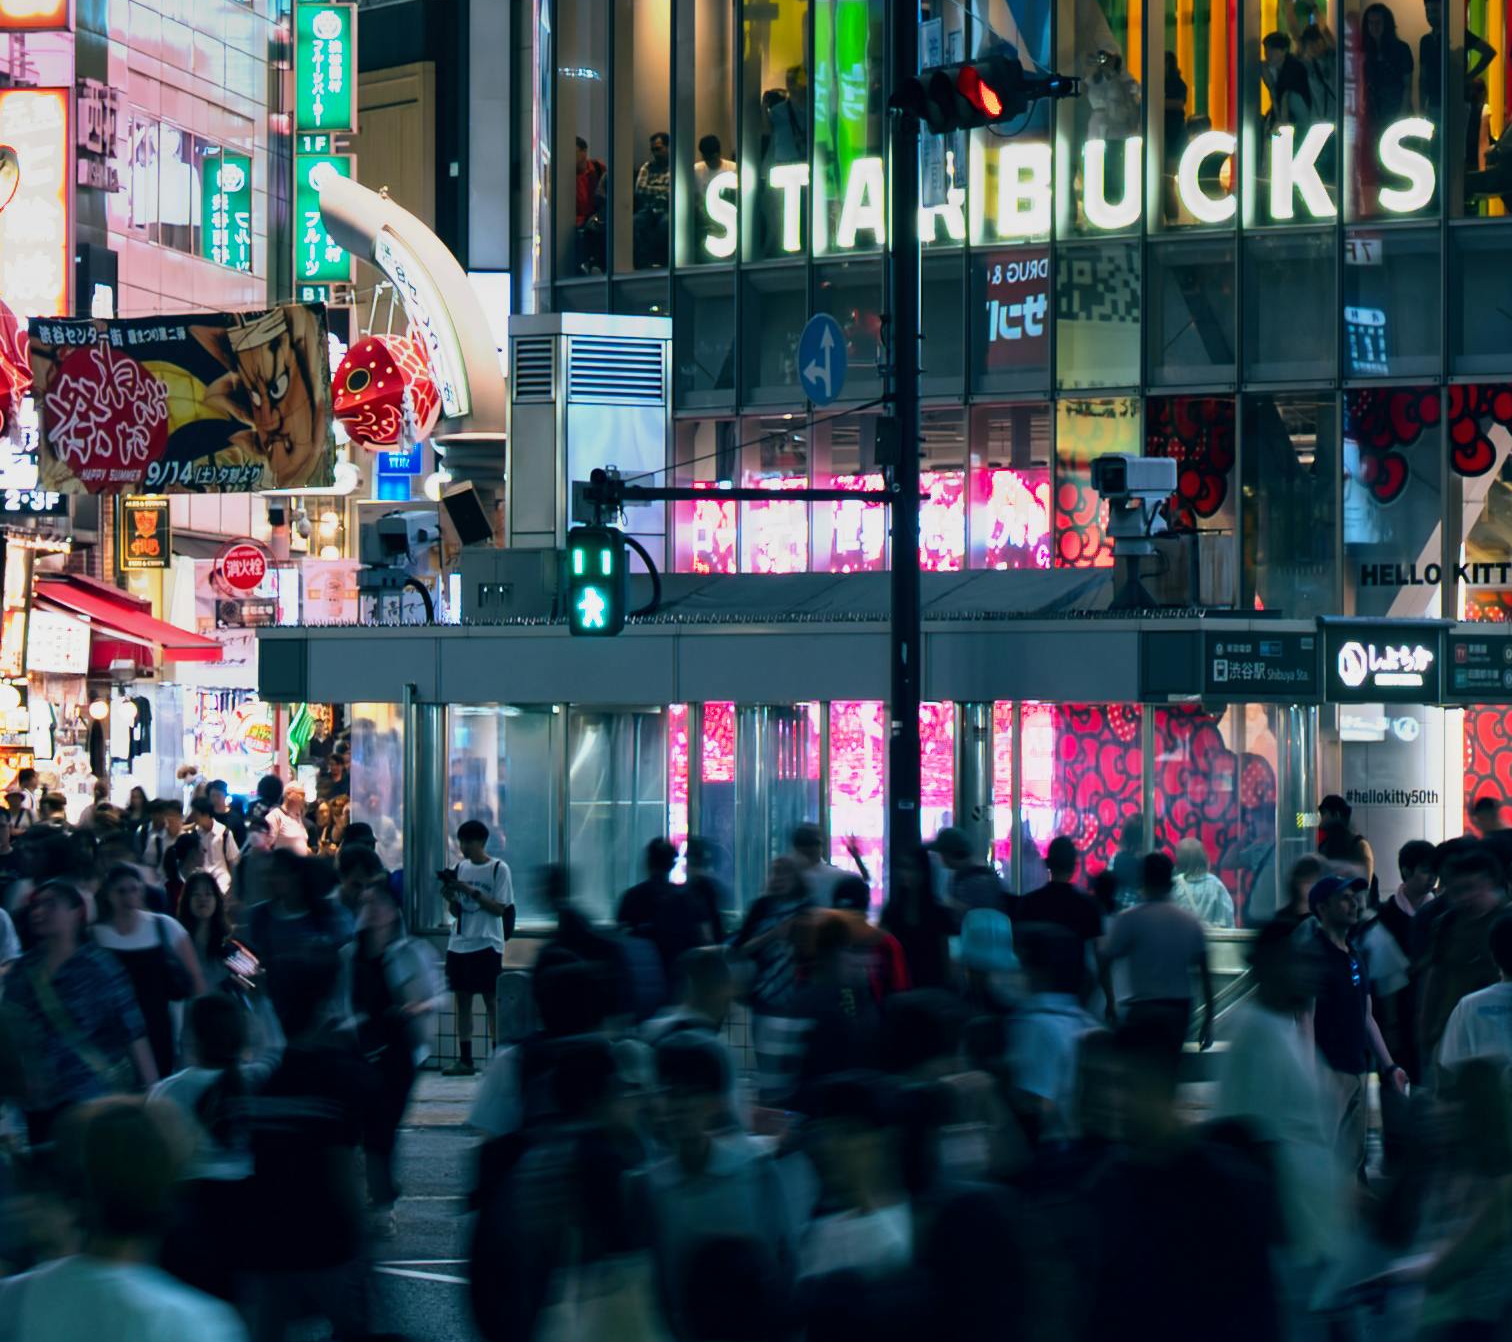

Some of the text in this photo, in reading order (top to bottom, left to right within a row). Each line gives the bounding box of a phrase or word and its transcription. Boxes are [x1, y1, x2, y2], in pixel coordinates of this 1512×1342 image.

[302, 136, 326, 152] 1F
[39, 325, 123, 348] 渋谷センター街
[81, 468, 142, 482] HAPPY SUMMER
[226, 559, 263, 578] 消火栓
[1360, 562, 1442, 587] HELLO
[1228, 661, 1266, 680] 渋谷駅
[1346, 789, 1439, 807] #hellokitty50th
